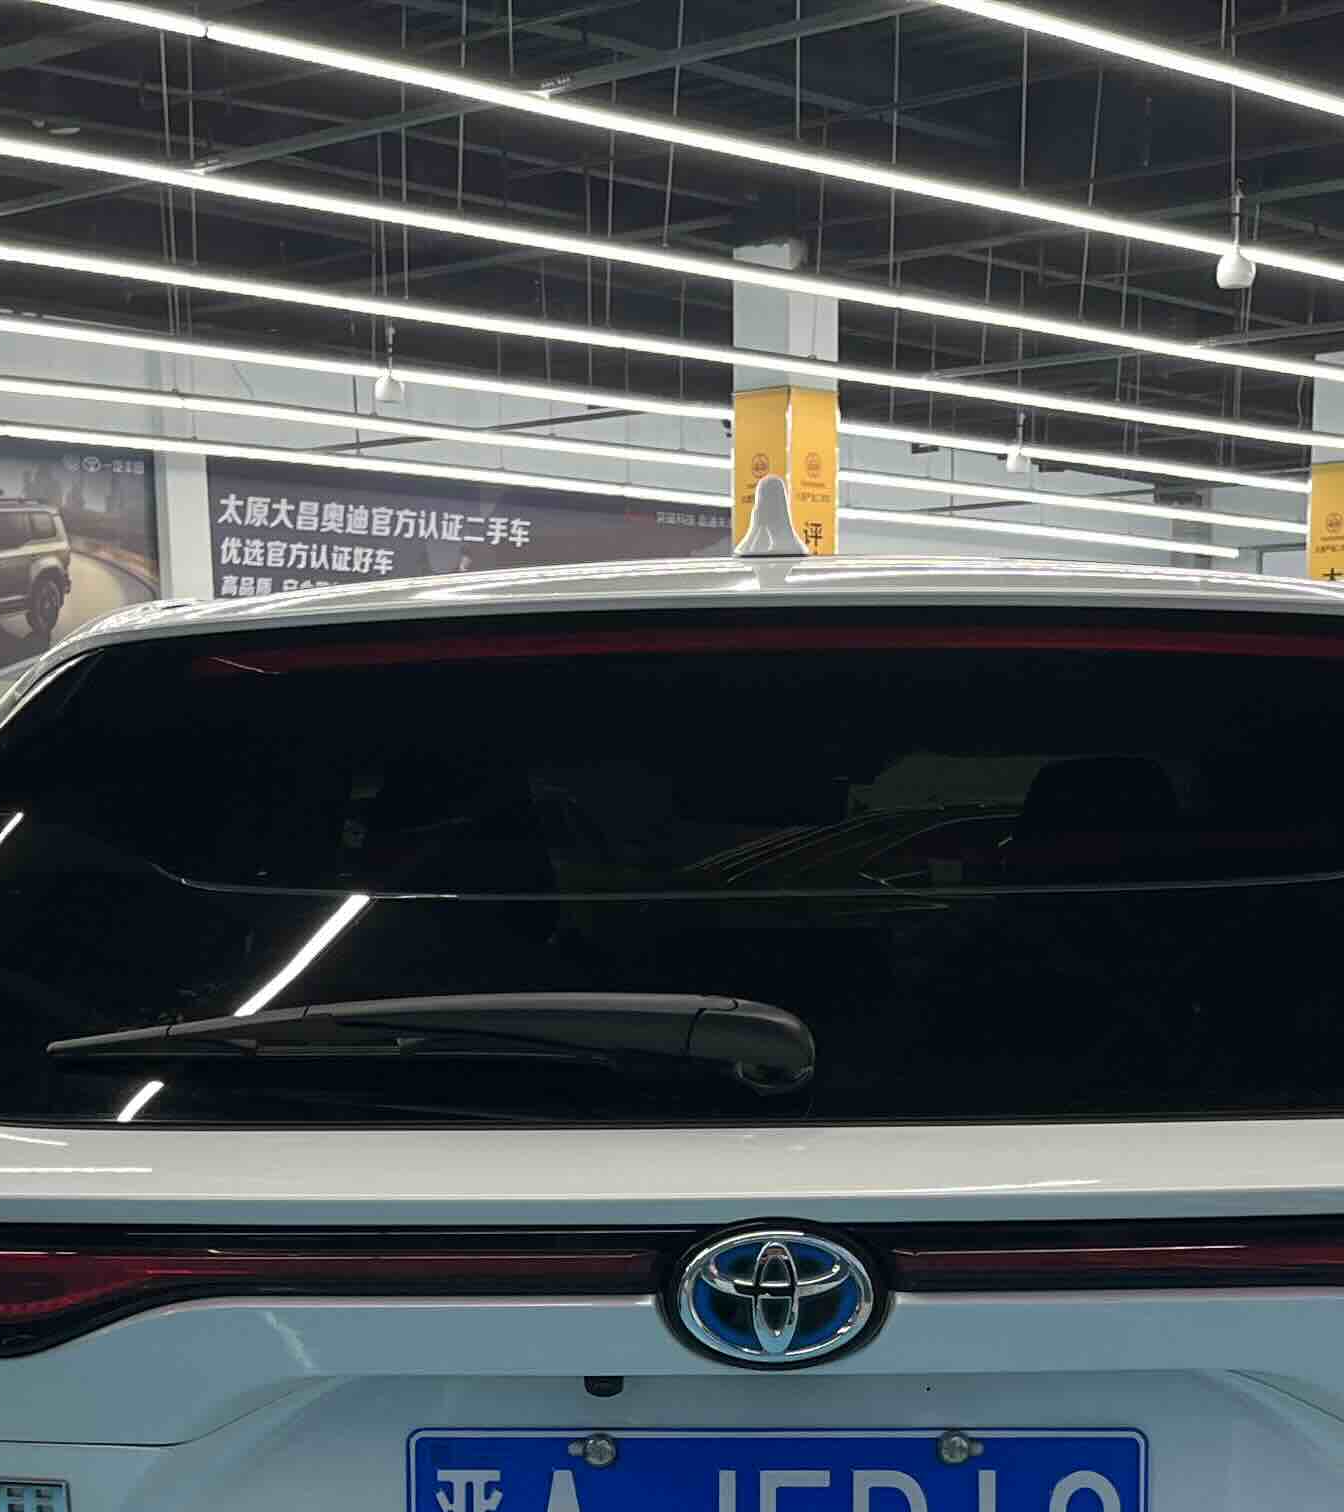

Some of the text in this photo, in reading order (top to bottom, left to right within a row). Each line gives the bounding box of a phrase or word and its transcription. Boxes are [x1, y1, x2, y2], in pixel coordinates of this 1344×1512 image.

[217, 493, 532, 548] 太原大昌奥迪官方认证二手车
[220, 536, 395, 576] 优选官方认证好车
